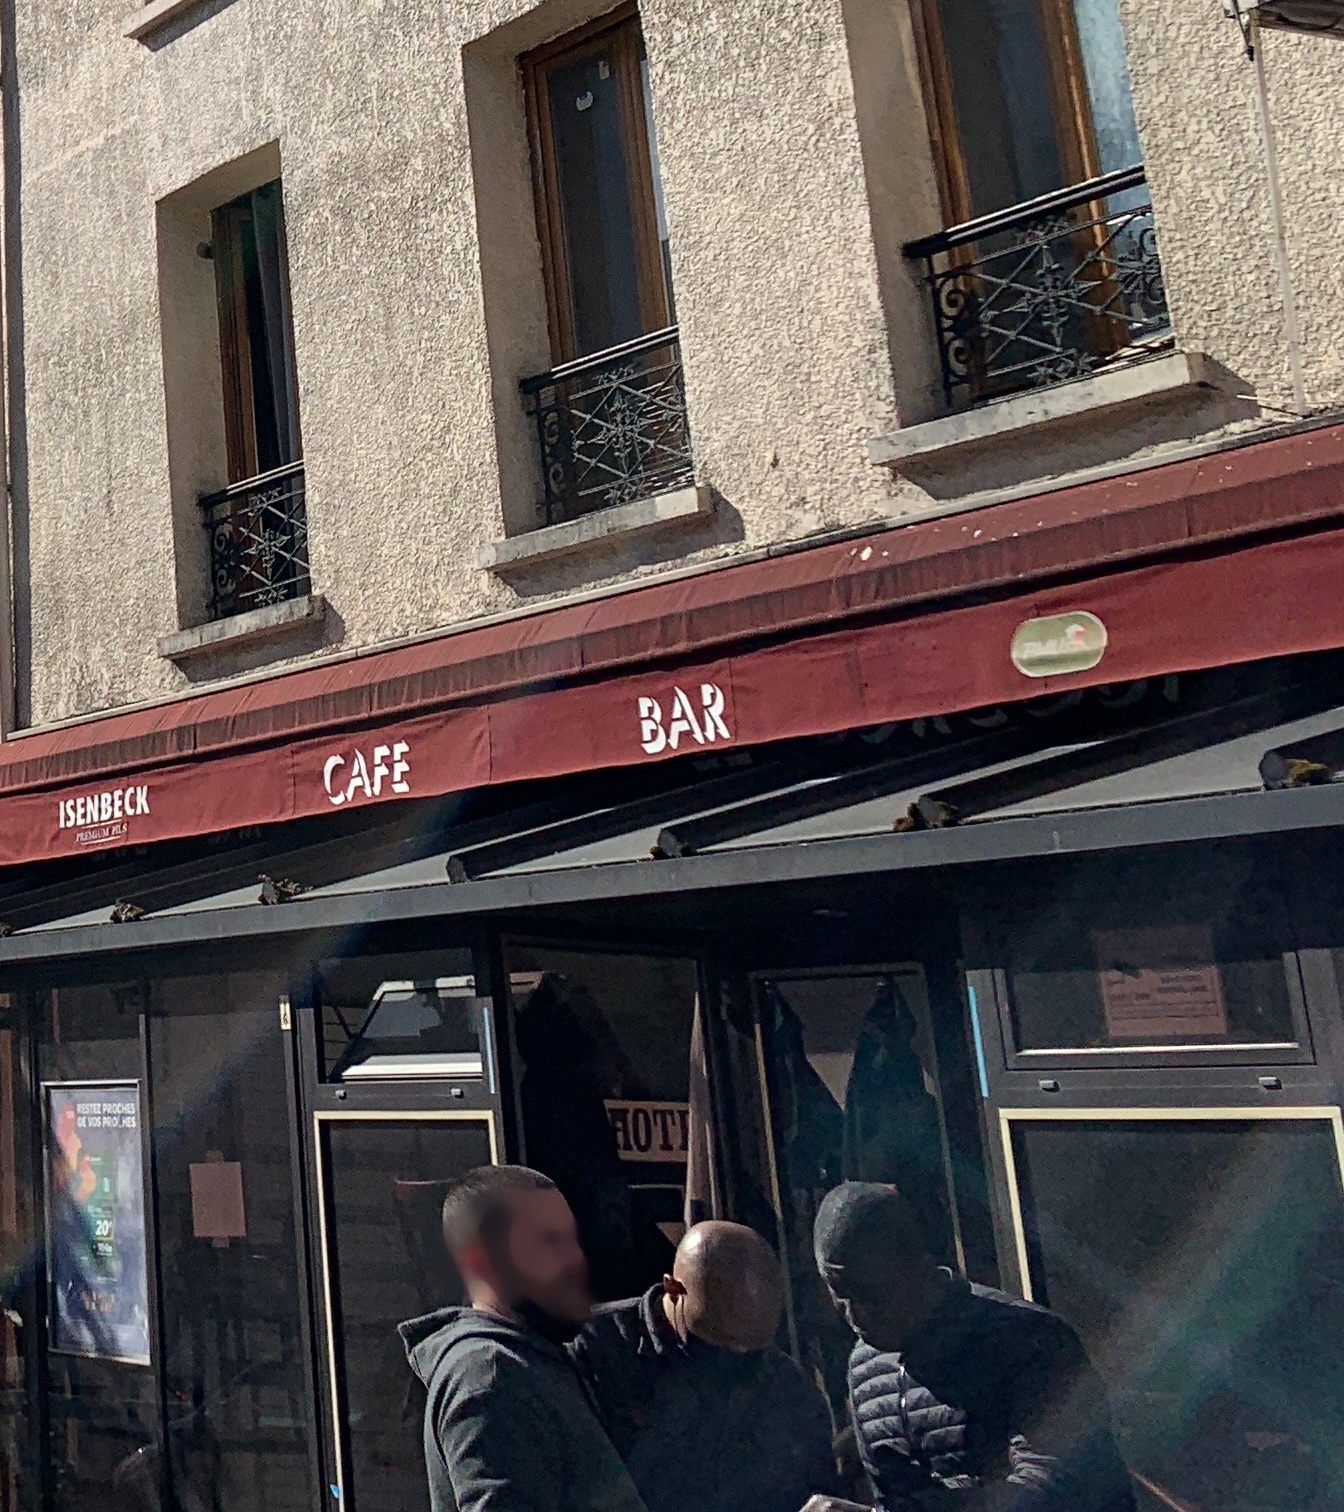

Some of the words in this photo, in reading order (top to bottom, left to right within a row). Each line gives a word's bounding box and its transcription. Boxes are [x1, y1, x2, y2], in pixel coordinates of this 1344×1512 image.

[638, 683, 732, 755] BAR
[323, 740, 411, 806] CAFE
[58, 785, 151, 829] ISENBECK
[75, 827, 110, 843] PREMIUM
[102, 1102, 136, 1115] PROCHES
